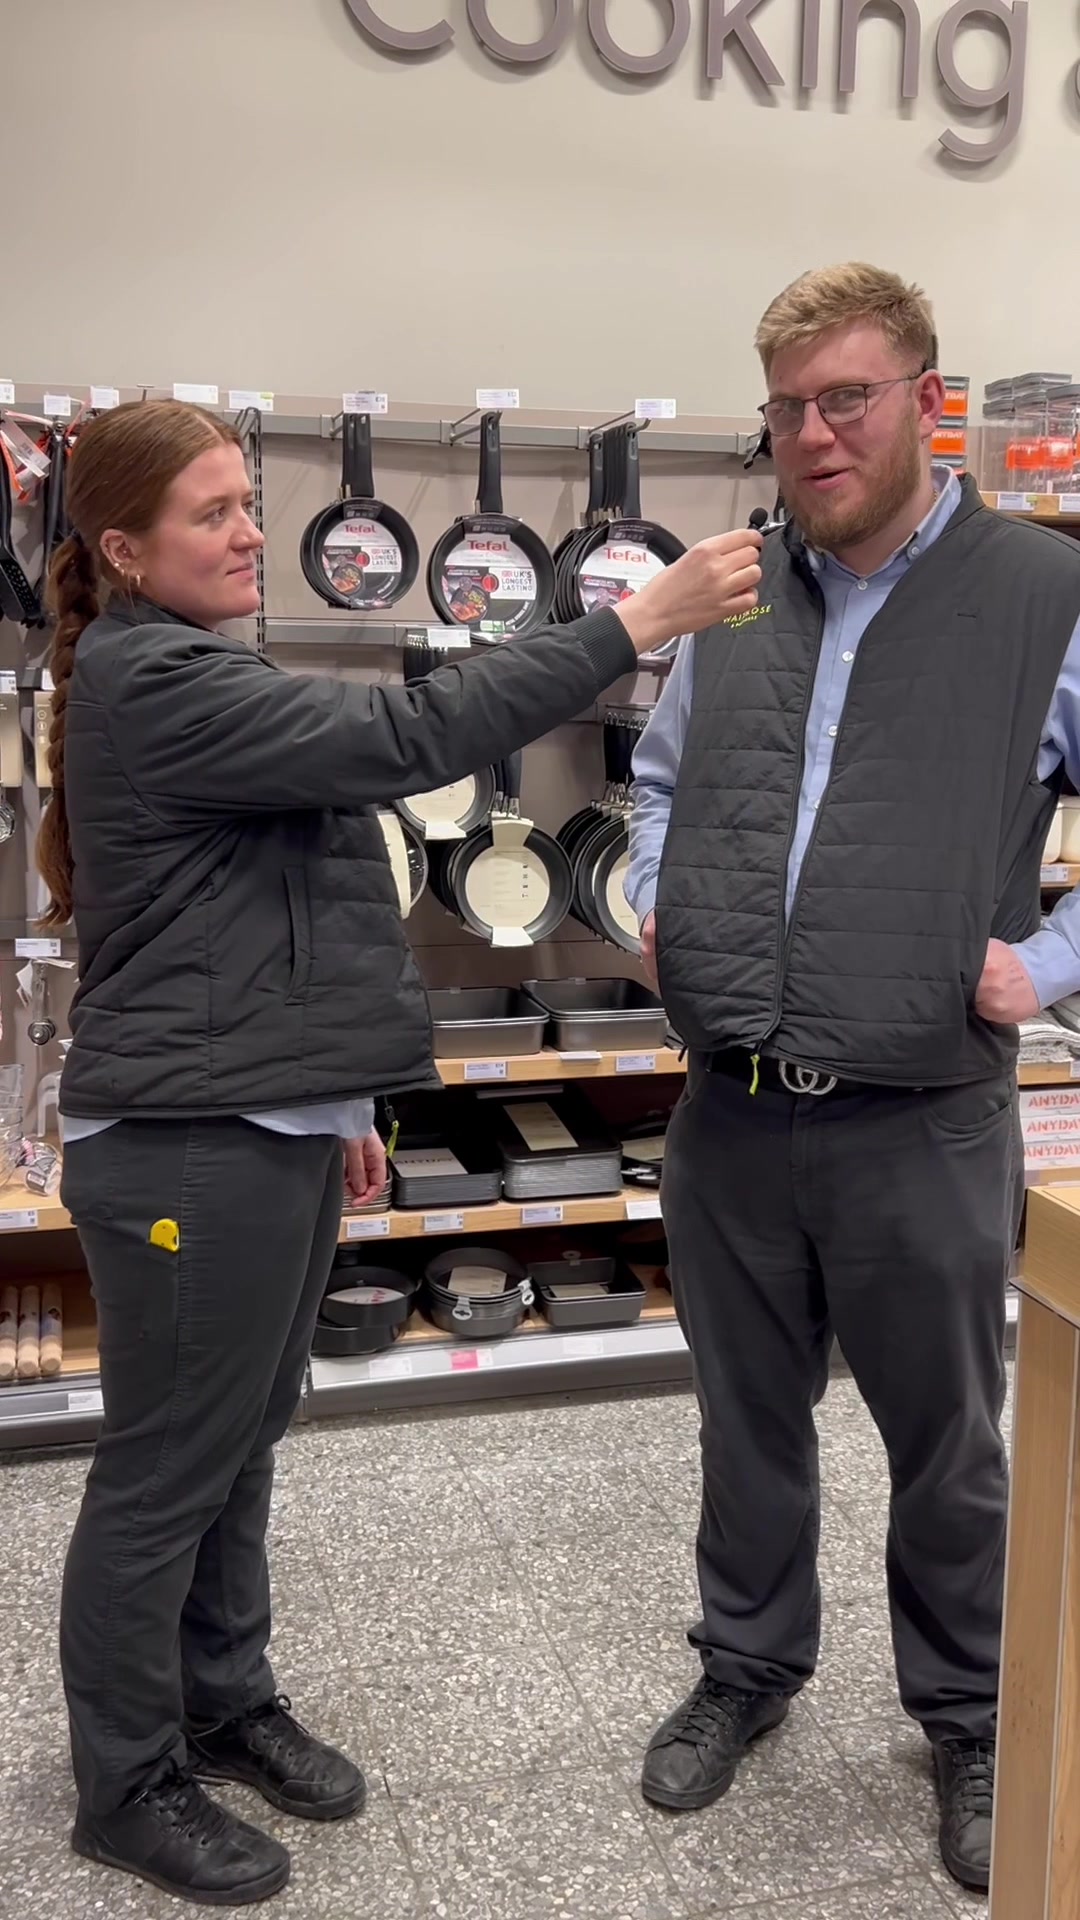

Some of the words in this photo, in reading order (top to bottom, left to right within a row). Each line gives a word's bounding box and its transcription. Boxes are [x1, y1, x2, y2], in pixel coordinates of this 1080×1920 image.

[344, 524, 376, 534] Tefal
[468, 540, 510, 552] Tefal
[603, 547, 649, 565] Tefal
[513, 570, 532, 579] UK'S
[501, 578, 532, 586] LONGEST
[1028, 1093, 1080, 1108] ANYDA
[1027, 1118, 1080, 1133] ANYDA
